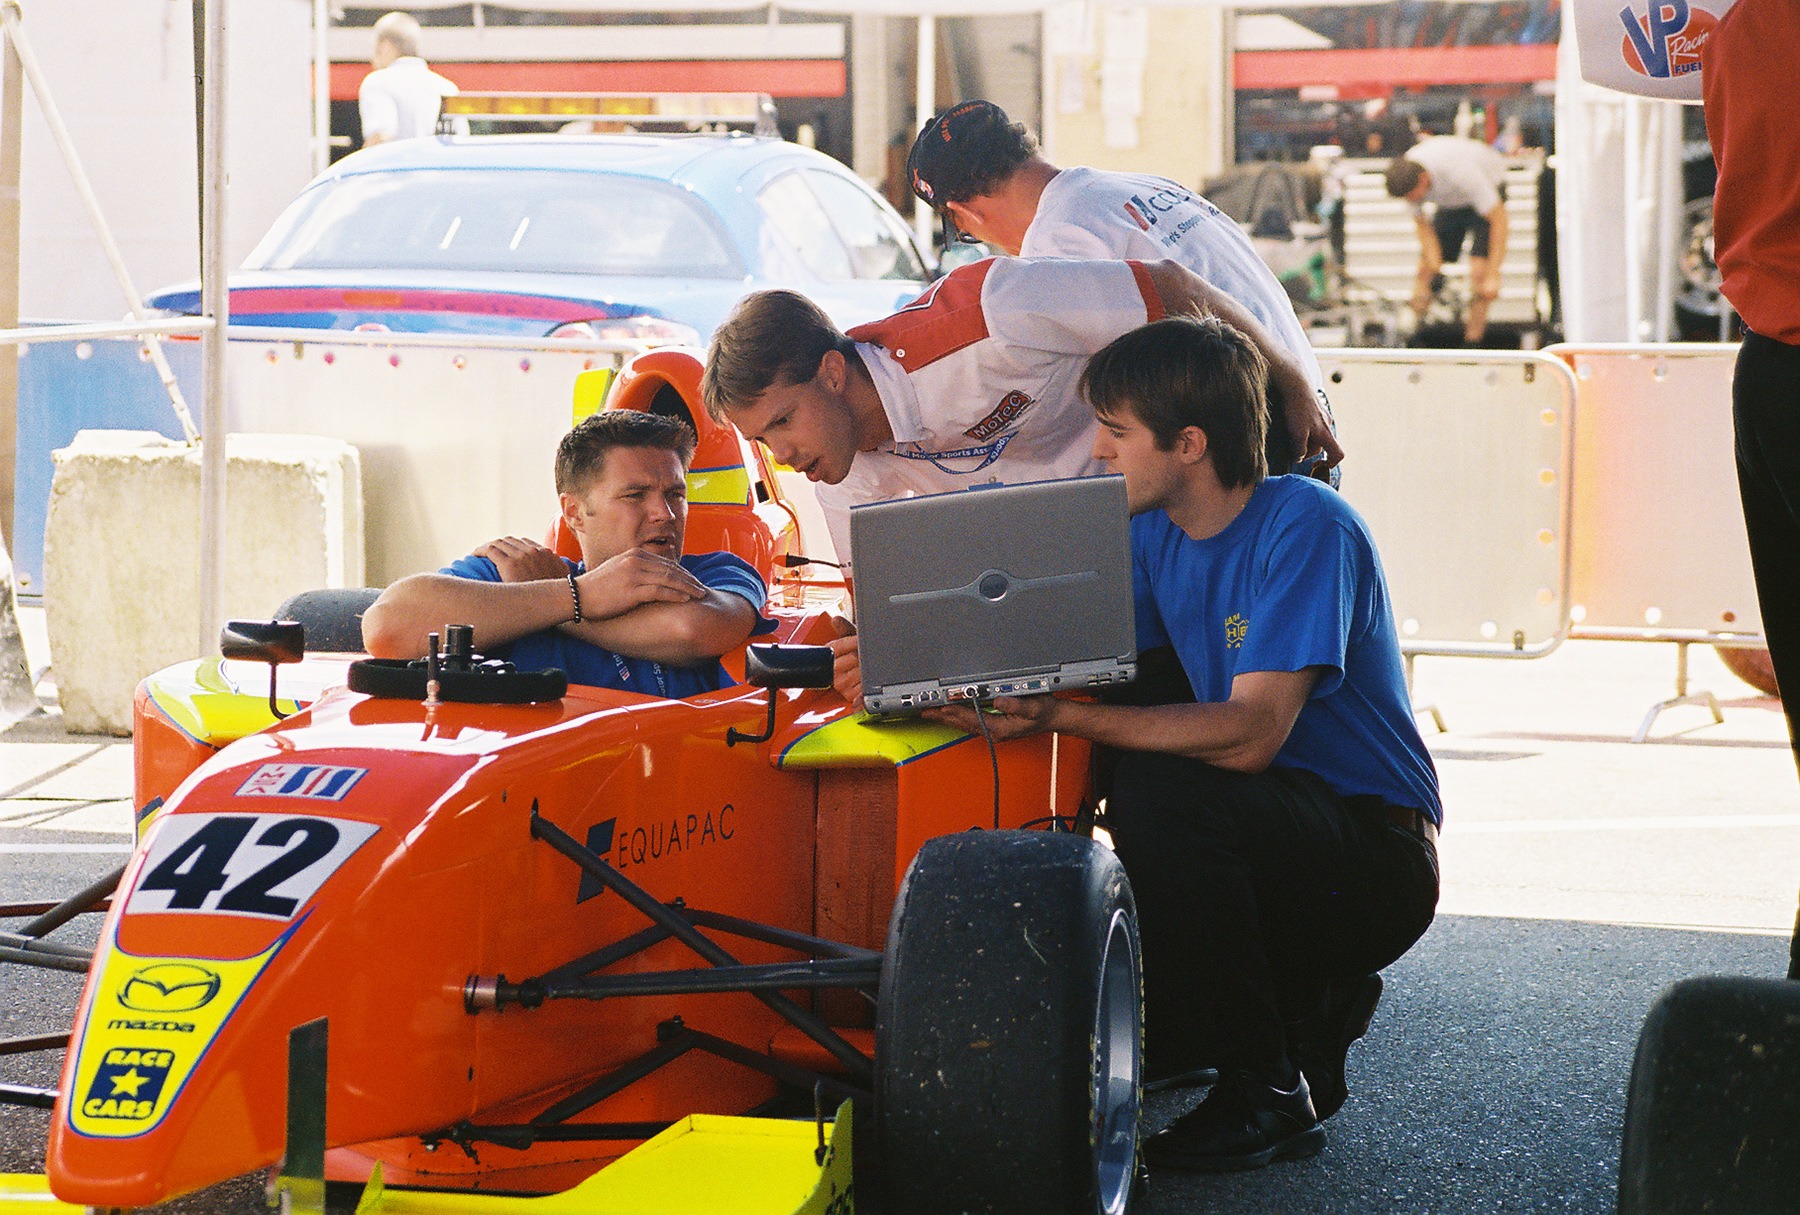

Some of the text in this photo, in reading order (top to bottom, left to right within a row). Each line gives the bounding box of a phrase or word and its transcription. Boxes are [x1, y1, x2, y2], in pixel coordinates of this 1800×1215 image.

[1618, 0, 1690, 78] VP
[941, 449, 971, 460] Sports
[618, 803, 735, 869] EQUAPAC
[138, 816, 340, 918] 42
[105, 1049, 173, 1069] RACE
[83, 1097, 154, 1118] CARS
